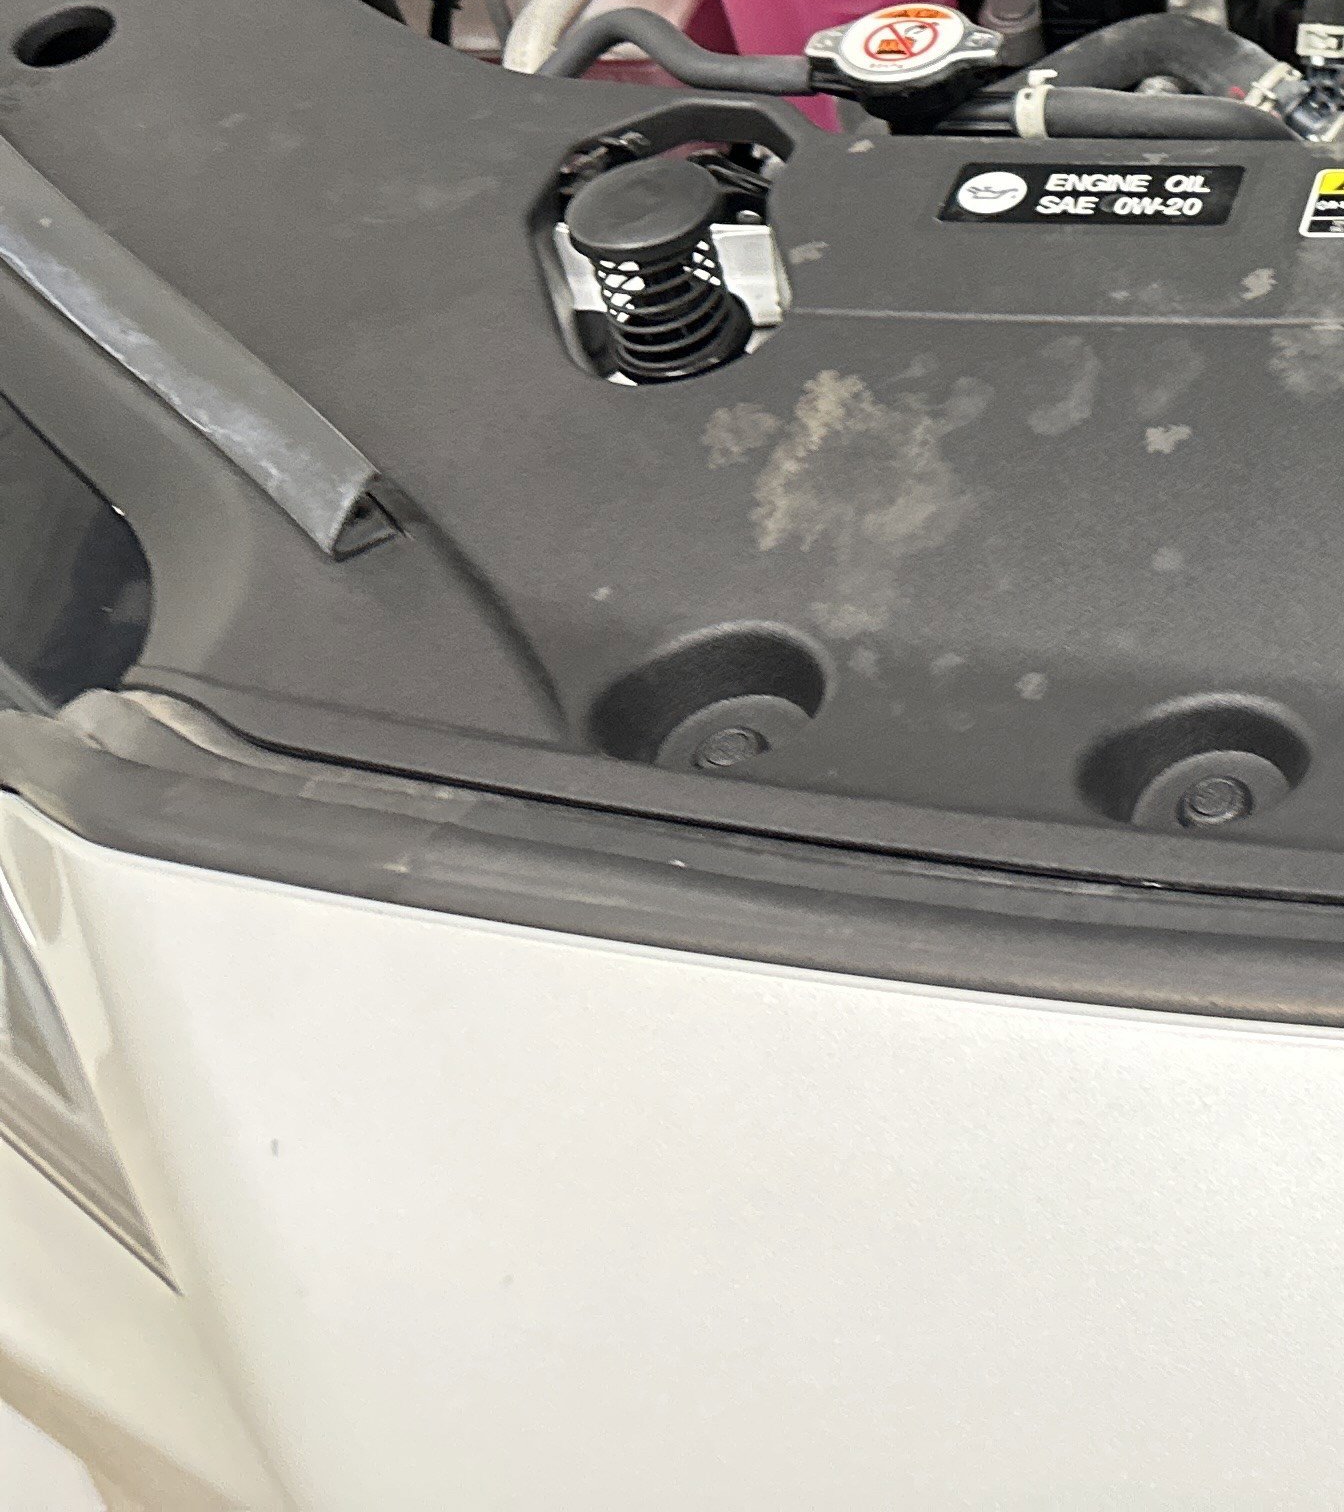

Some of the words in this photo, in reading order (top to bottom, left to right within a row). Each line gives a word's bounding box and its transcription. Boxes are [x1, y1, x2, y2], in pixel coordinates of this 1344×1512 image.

[1045, 173, 1152, 193] ENGINE
[1164, 174, 1211, 194] OIL
[1035, 196, 1099, 216] SAE
[1112, 197, 1203, 216] 0W-20
